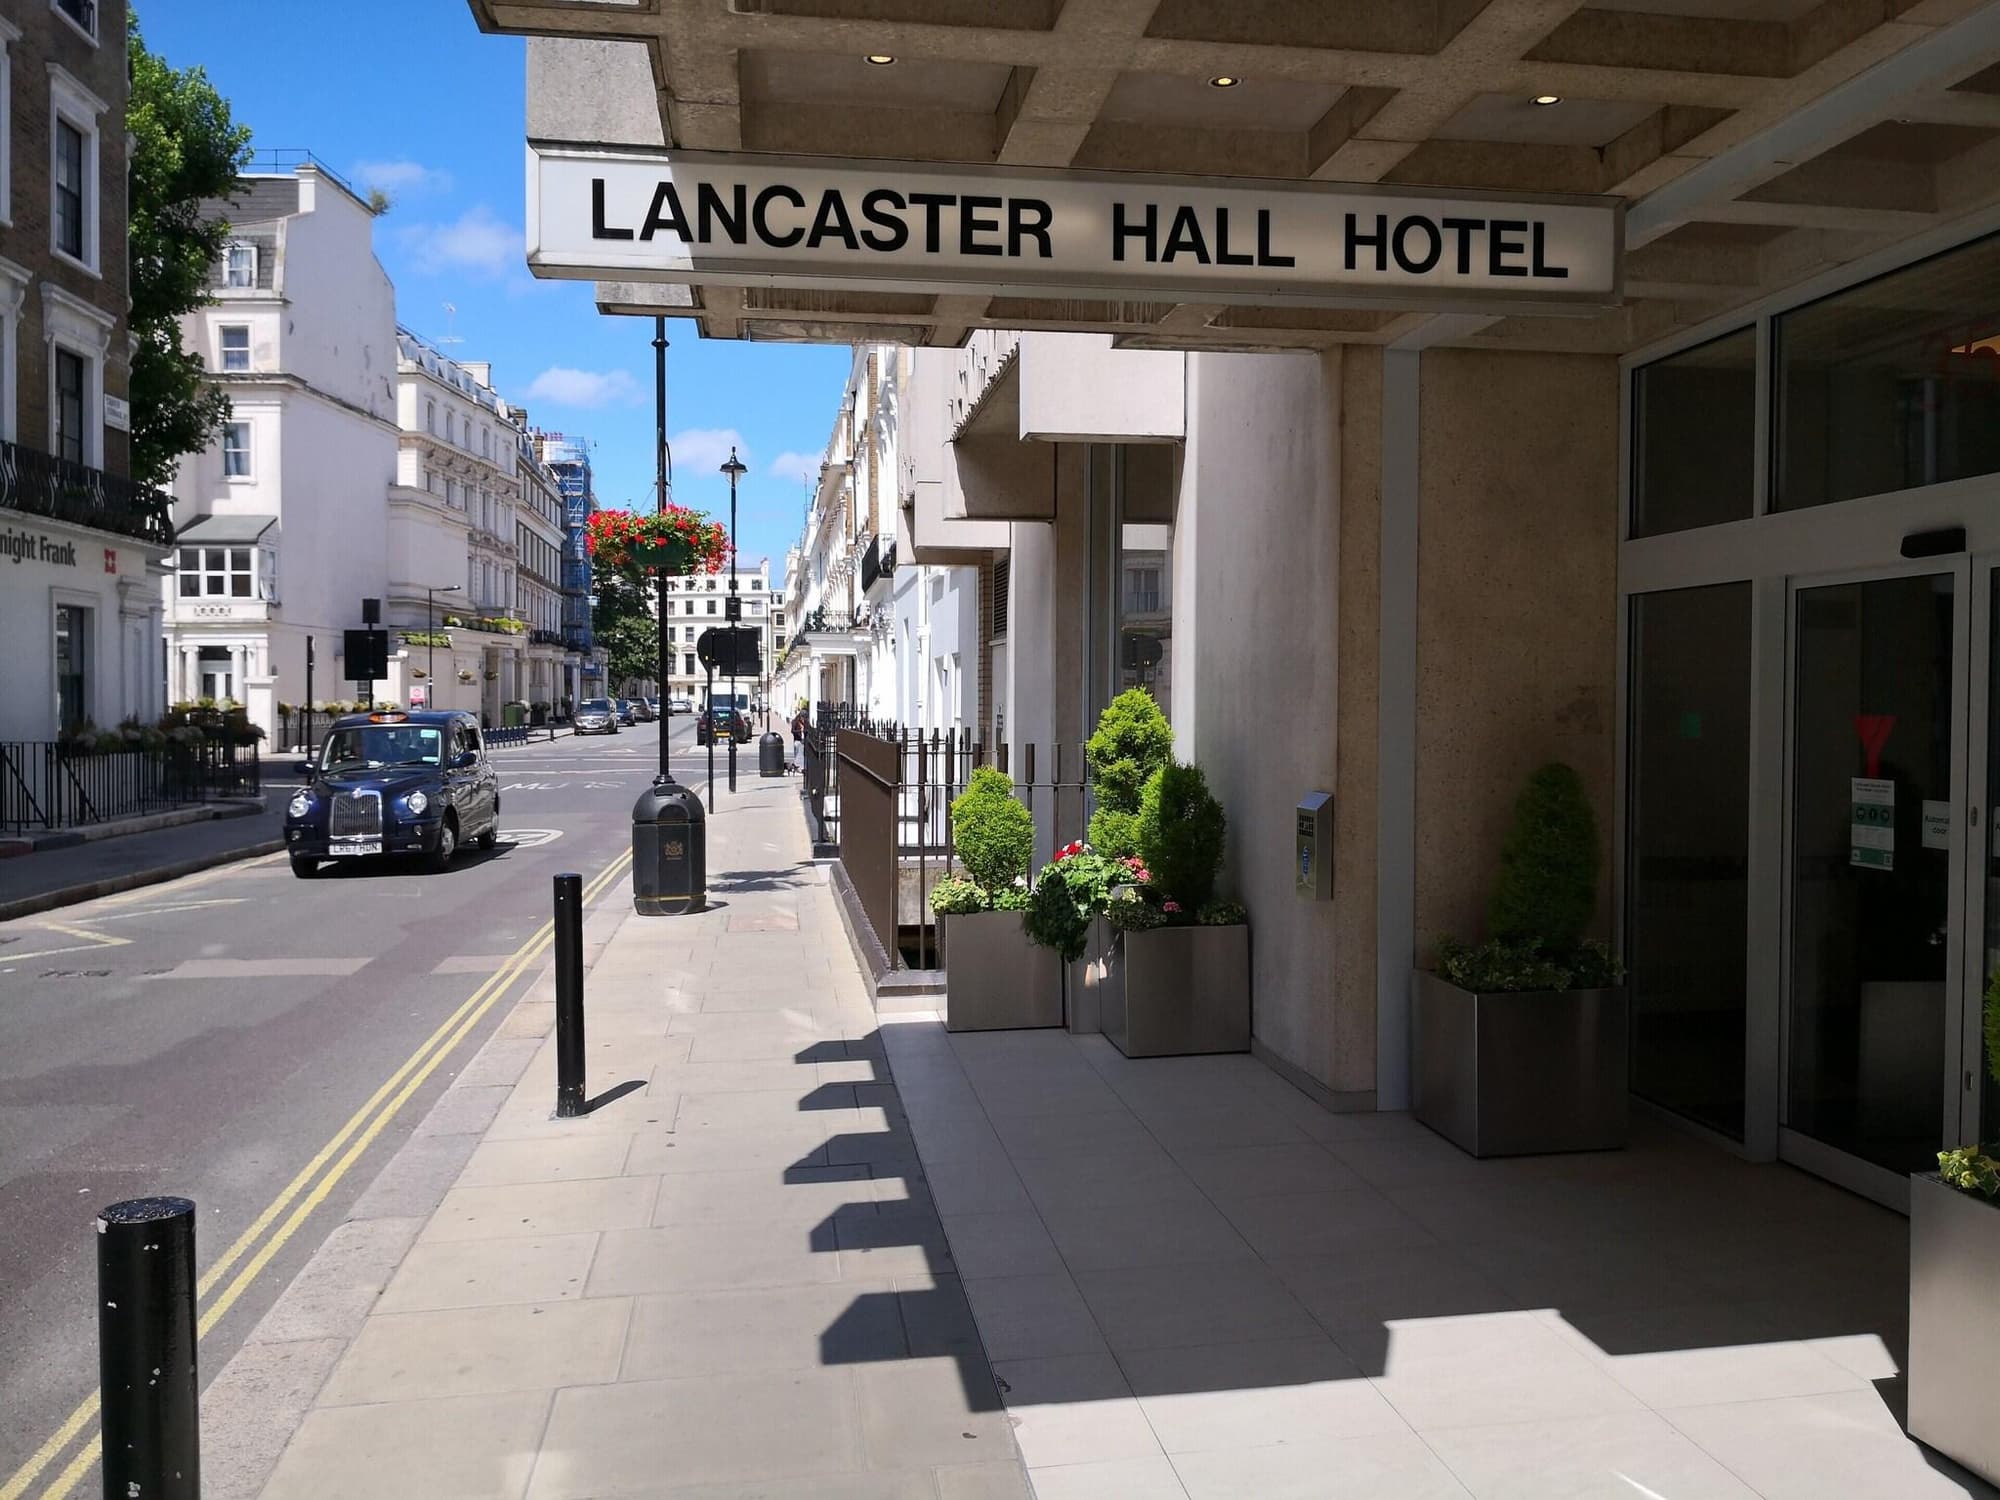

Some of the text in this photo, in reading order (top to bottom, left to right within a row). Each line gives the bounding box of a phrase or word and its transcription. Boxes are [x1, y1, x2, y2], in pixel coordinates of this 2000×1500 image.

[592, 178, 1569, 279] LANCASTER HALL HOTEL
[40, 535, 76, 567] Frank
